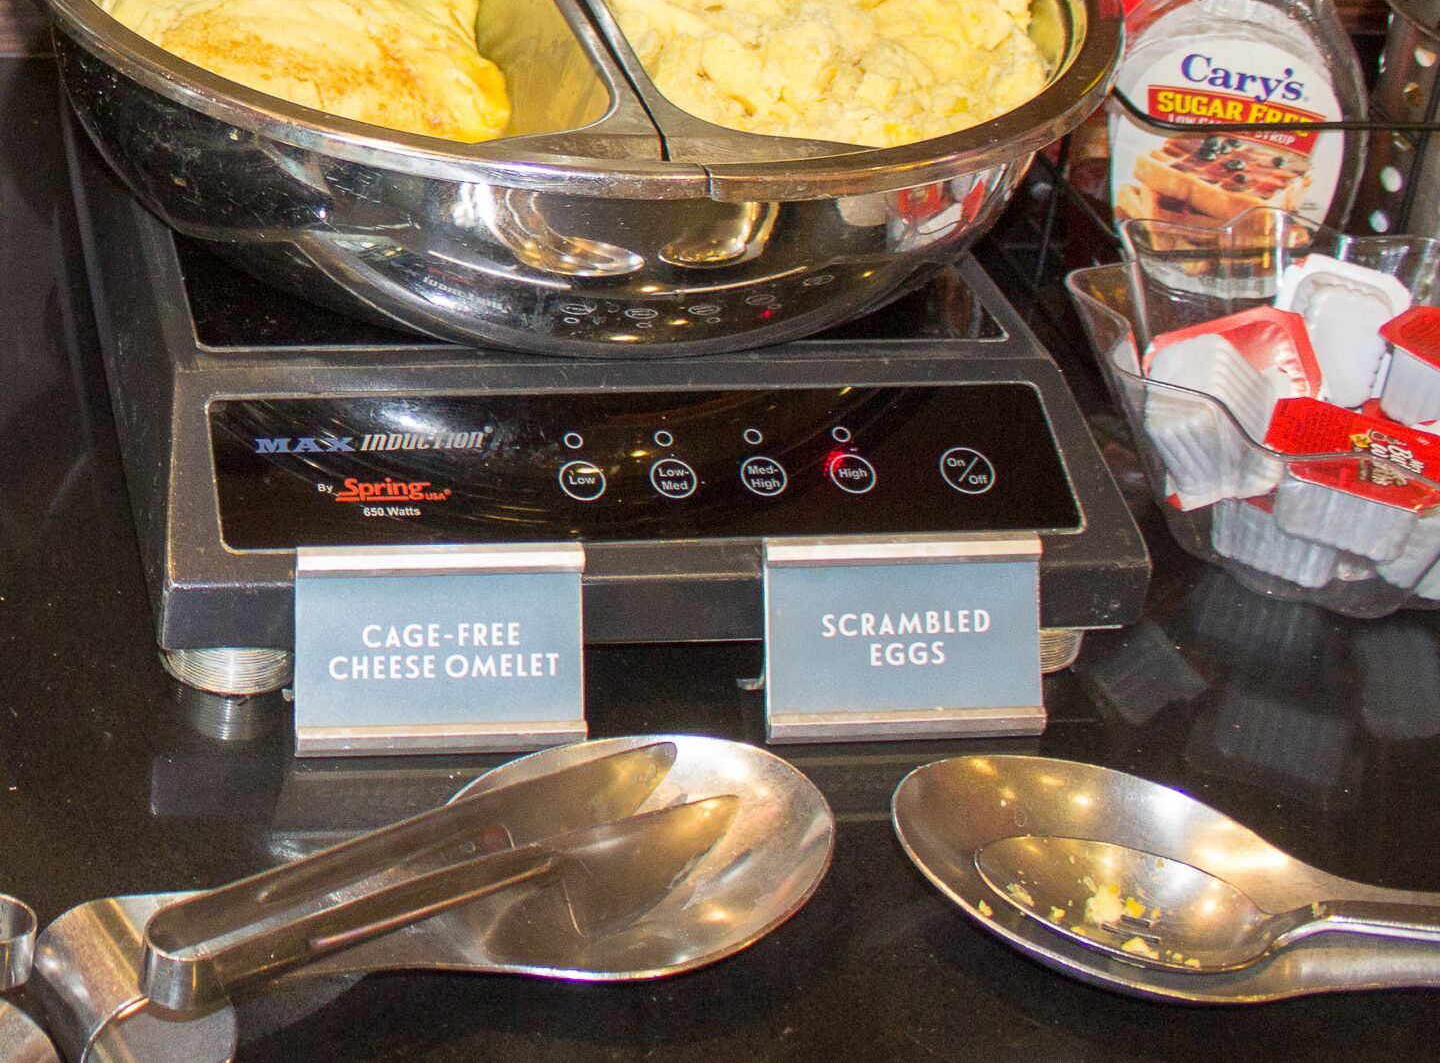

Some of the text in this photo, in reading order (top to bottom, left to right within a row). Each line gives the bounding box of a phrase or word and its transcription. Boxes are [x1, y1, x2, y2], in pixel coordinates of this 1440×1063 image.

[1180, 53, 1305, 103] Cary's
[1157, 90, 1244, 122] SUGAR
[255, 431, 484, 454] MAX INDUCTION
[747, 463, 778, 476] Med-
[947, 457, 966, 469] On
[658, 466, 689, 478] Low-
[838, 467, 868, 481] High
[968, 473, 988, 485] Off
[569, 474, 596, 486] Low
[661, 480, 688, 492] Med
[750, 477, 780, 490] High
[317, 482, 333, 494] By
[340, 477, 431, 501] Spring
[363, 506, 421, 517] 650 Watts
[820, 609, 992, 639] SCRAMBLED
[361, 622, 521, 649] CAGE-FREE
[868, 641, 946, 668] EGGS
[327, 652, 560, 681] CHEESE OMELET
